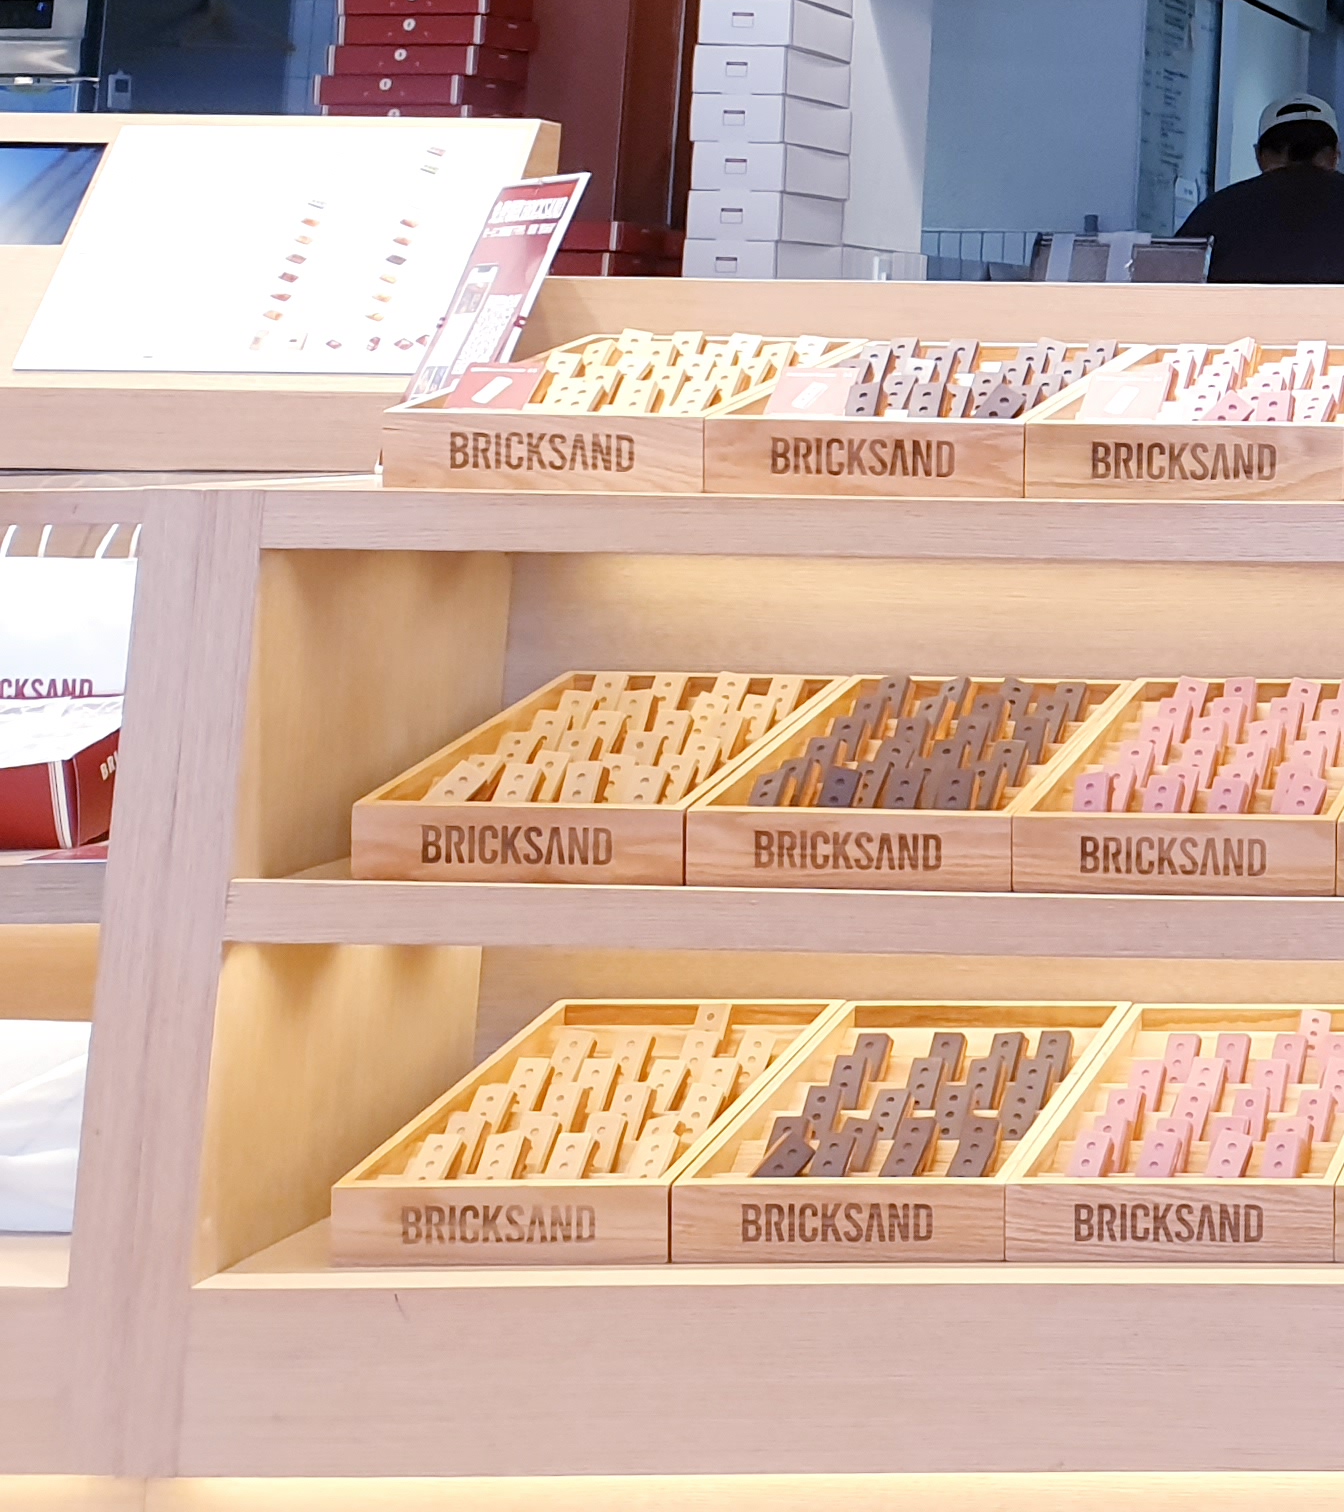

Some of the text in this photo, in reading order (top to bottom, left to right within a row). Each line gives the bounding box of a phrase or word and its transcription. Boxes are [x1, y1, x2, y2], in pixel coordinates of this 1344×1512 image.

[450, 431, 634, 475] BRICKSAND
[770, 435, 954, 479] BRICKSAND
[1092, 440, 1276, 483] BRICKSAND
[421, 824, 612, 866] BRICKSAND
[754, 830, 942, 871] BRICKSAND
[1080, 836, 1266, 876] BRICKSAND
[399, 1207, 596, 1245] BRICKSAND
[740, 1207, 934, 1245] BRICKSAND
[1072, 1204, 1267, 1244] BRICKSAND
